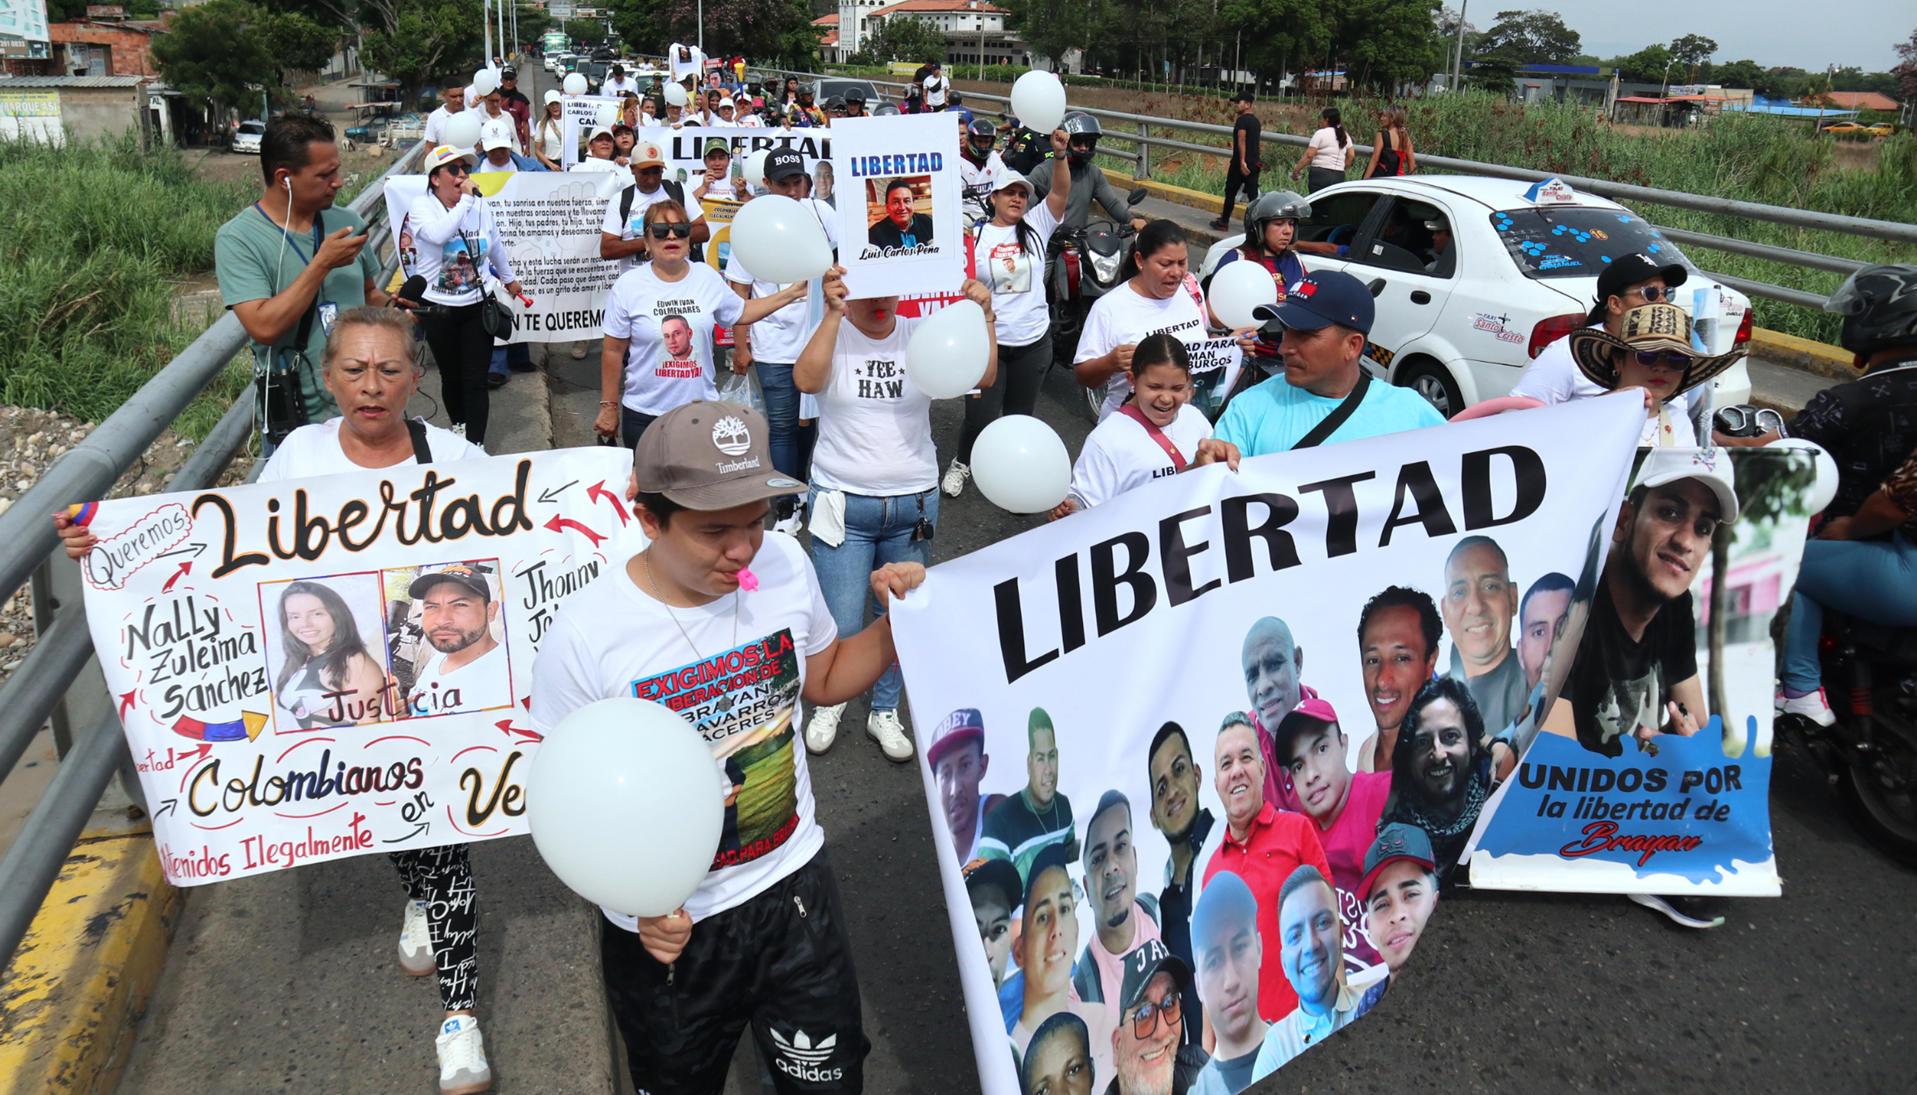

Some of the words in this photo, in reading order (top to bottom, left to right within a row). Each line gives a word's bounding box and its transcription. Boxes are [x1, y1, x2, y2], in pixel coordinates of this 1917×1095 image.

[774, 154, 801, 166] BOSS
[851, 151, 943, 178] LIBERTAD
[513, 199, 536, 207] sonrisa
[547, 199, 571, 207] nuestra
[506, 209, 534, 217] nuestras
[535, 208, 567, 217] oraciones
[573, 208, 580, 216] te
[519, 229, 526, 237] te
[561, 227, 592, 236] deseamos
[525, 219, 535, 227] tus
[537, 218, 560, 229] padres,
[562, 218, 569, 226] tu
[528, 258, 542, 266] esta
[544, 256, 562, 266] lucha
[859, 247, 881, 260] Luis
[884, 245, 913, 259] Carlos
[515, 267, 525, 277] de
[525, 267, 533, 277] la
[533, 266, 555, 276] fuerza
[555, 268, 567, 277] que
[576, 265, 604, 274] encuentra
[605, 264, 613, 272] en
[540, 276, 559, 285] Cada
[560, 276, 575, 287] paso
[575, 275, 588, 284] que
[521, 288, 537, 297] mos,
[546, 286, 555, 294] un
[555, 285, 571, 297] grito
[572, 284, 580, 293] de
[653, 305, 702, 316] COLMENARES
[656, 299, 679, 308] EDWIN
[679, 298, 695, 307] IVAN
[524, 313, 541, 332] TE
[1474, 317, 1501, 333] Santo
[1483, 313, 1497, 321] TAXI
[1145, 318, 1200, 338] LIBERTAD
[1496, 329, 1525, 344] Cristo
[1204, 338, 1236, 351] PARA
[865, 360, 896, 379] YEE
[1188, 355, 1232, 369] BURGOS
[655, 368, 692, 378] LIBERTAD
[858, 379, 904, 399] HAW
[716, 456, 760, 475] Timberland
[191, 459, 534, 579] Libertad
[86, 508, 188, 589] Queremos
[993, 444, 1547, 685] LIBERTAD
[150, 625, 256, 685] Zuleima
[635, 648, 760, 701] EXIGIMOS
[765, 631, 795, 660] LA
[760, 661, 783, 679] DE
[322, 678, 461, 724] Justicia
[187, 746, 425, 820] Colombianos
[1518, 762, 1668, 793] UNIDOS
[1679, 764, 1743, 795] POR
[401, 790, 435, 824] en
[1536, 794, 1569, 819] la
[1573, 794, 1691, 821] libertad
[1694, 798, 1731, 822] de
[239, 812, 375, 872] Ilegalmente
[1558, 820, 1704, 867] Brayan
[775, 1058, 843, 1082] adidas
